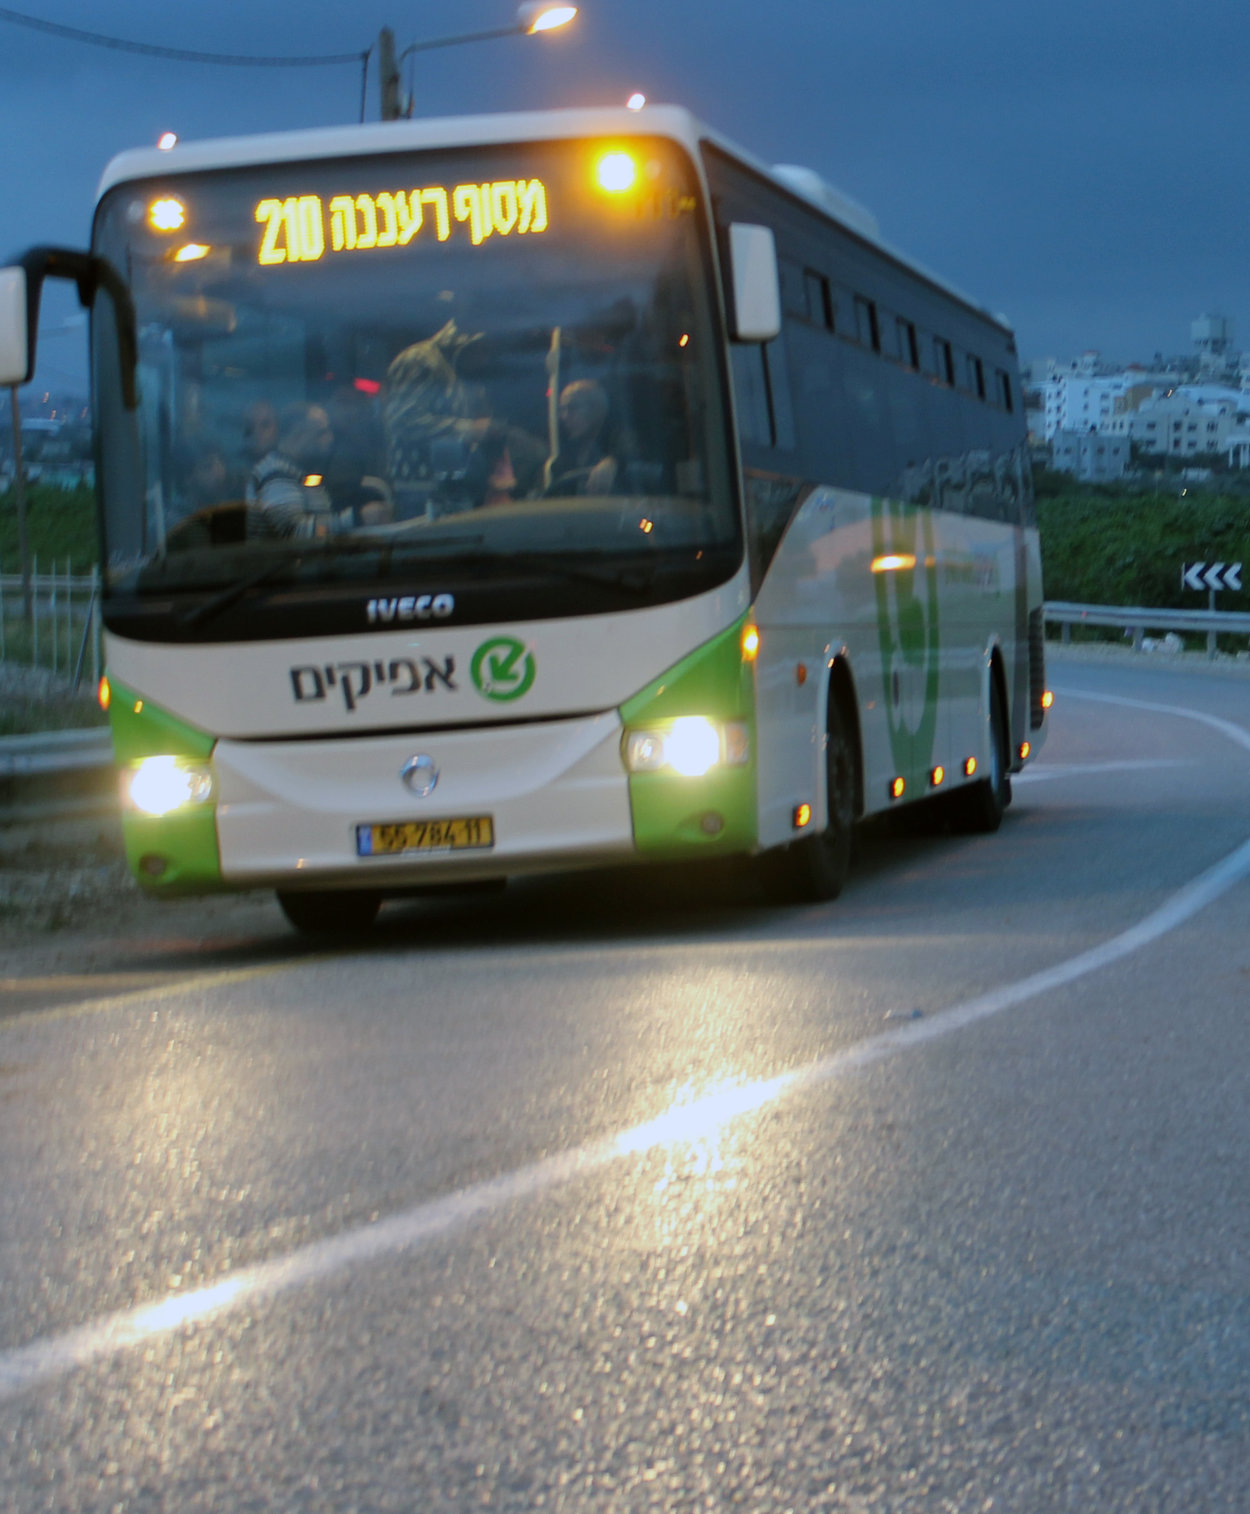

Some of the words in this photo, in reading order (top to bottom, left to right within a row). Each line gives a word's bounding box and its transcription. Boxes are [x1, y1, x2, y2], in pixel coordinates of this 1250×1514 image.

[254, 194, 326, 266] 210
[329, 186, 450, 251] רעננה
[453, 178, 549, 246] מסוף
[366, 593, 456, 624] IVECO
[290, 654, 459, 713] אפיקים
